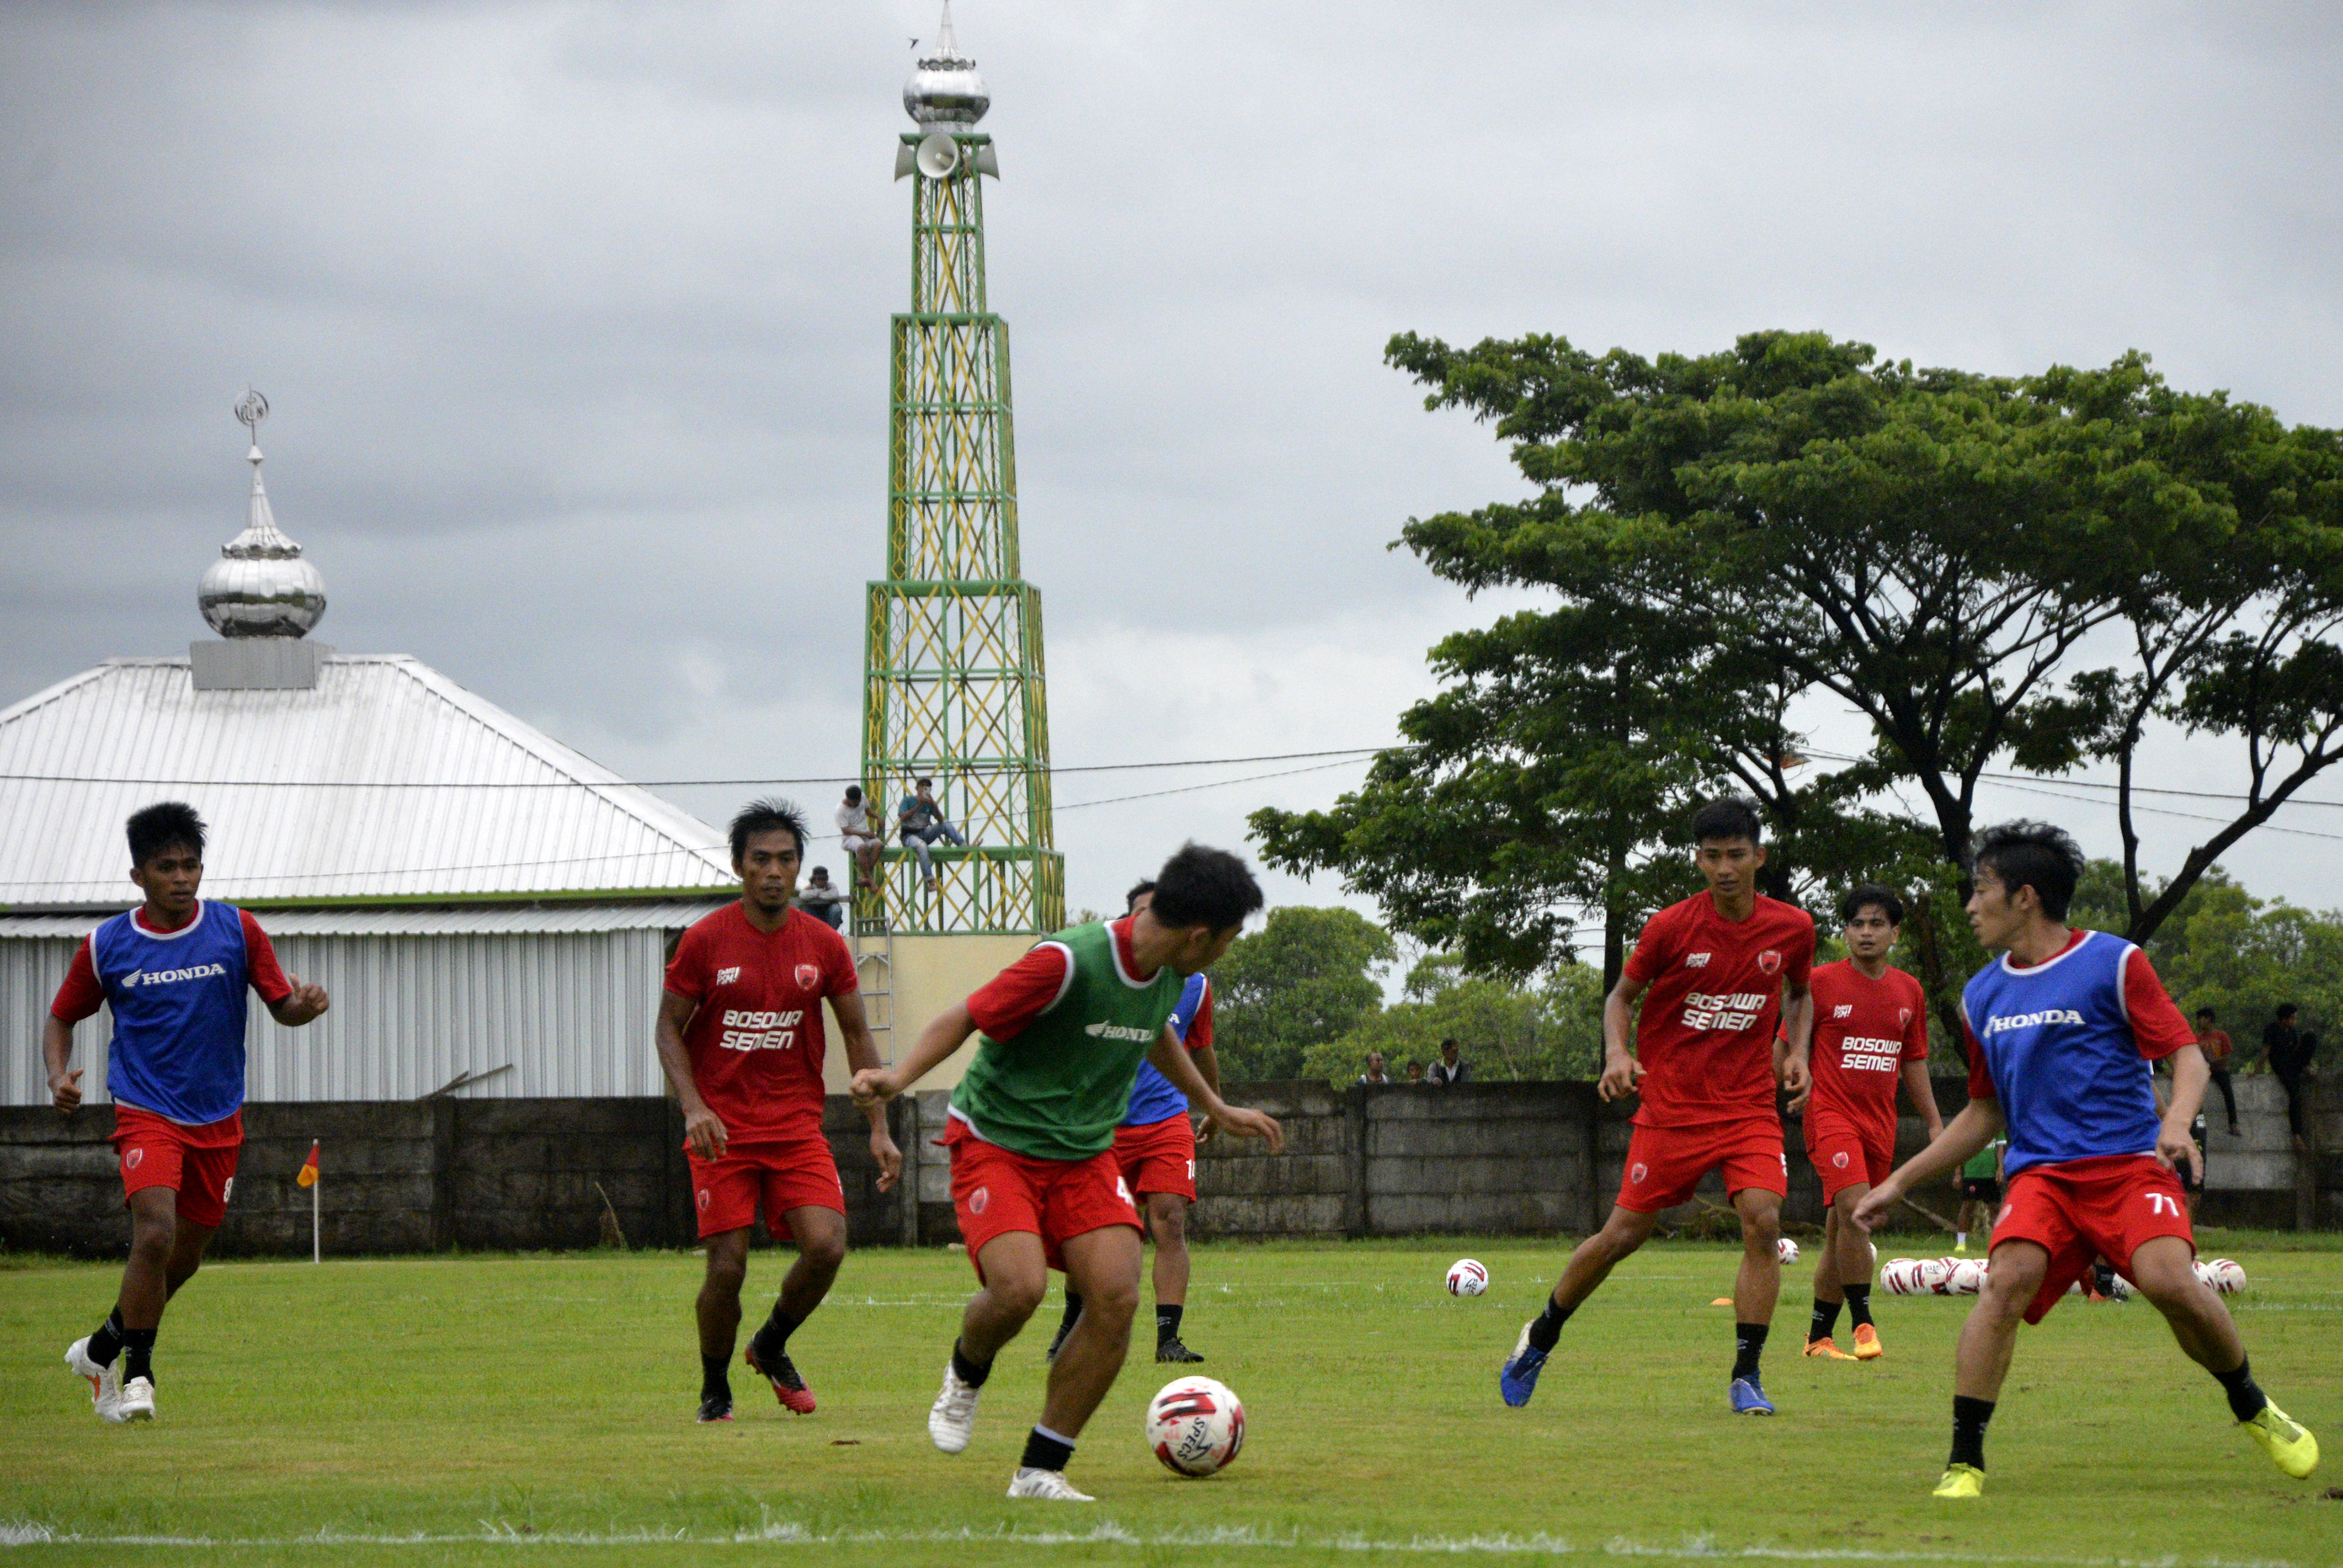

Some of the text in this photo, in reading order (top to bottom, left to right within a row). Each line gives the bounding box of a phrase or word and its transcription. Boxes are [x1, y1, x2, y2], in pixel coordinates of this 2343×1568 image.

[141, 963, 226, 985] HONDA
[1684, 992, 1767, 1011] BOSOWA
[722, 1009, 804, 1029] BOSOWA
[1681, 1009, 1757, 1031] SEMEN
[1993, 1009, 2086, 1032] HONDA
[1842, 1036, 1903, 1054] BOSOWA
[1840, 1053, 1897, 1072] SEMEN
[2145, 1193, 2180, 1217] 71
[1177, 1416, 1205, 1460] SPECS
